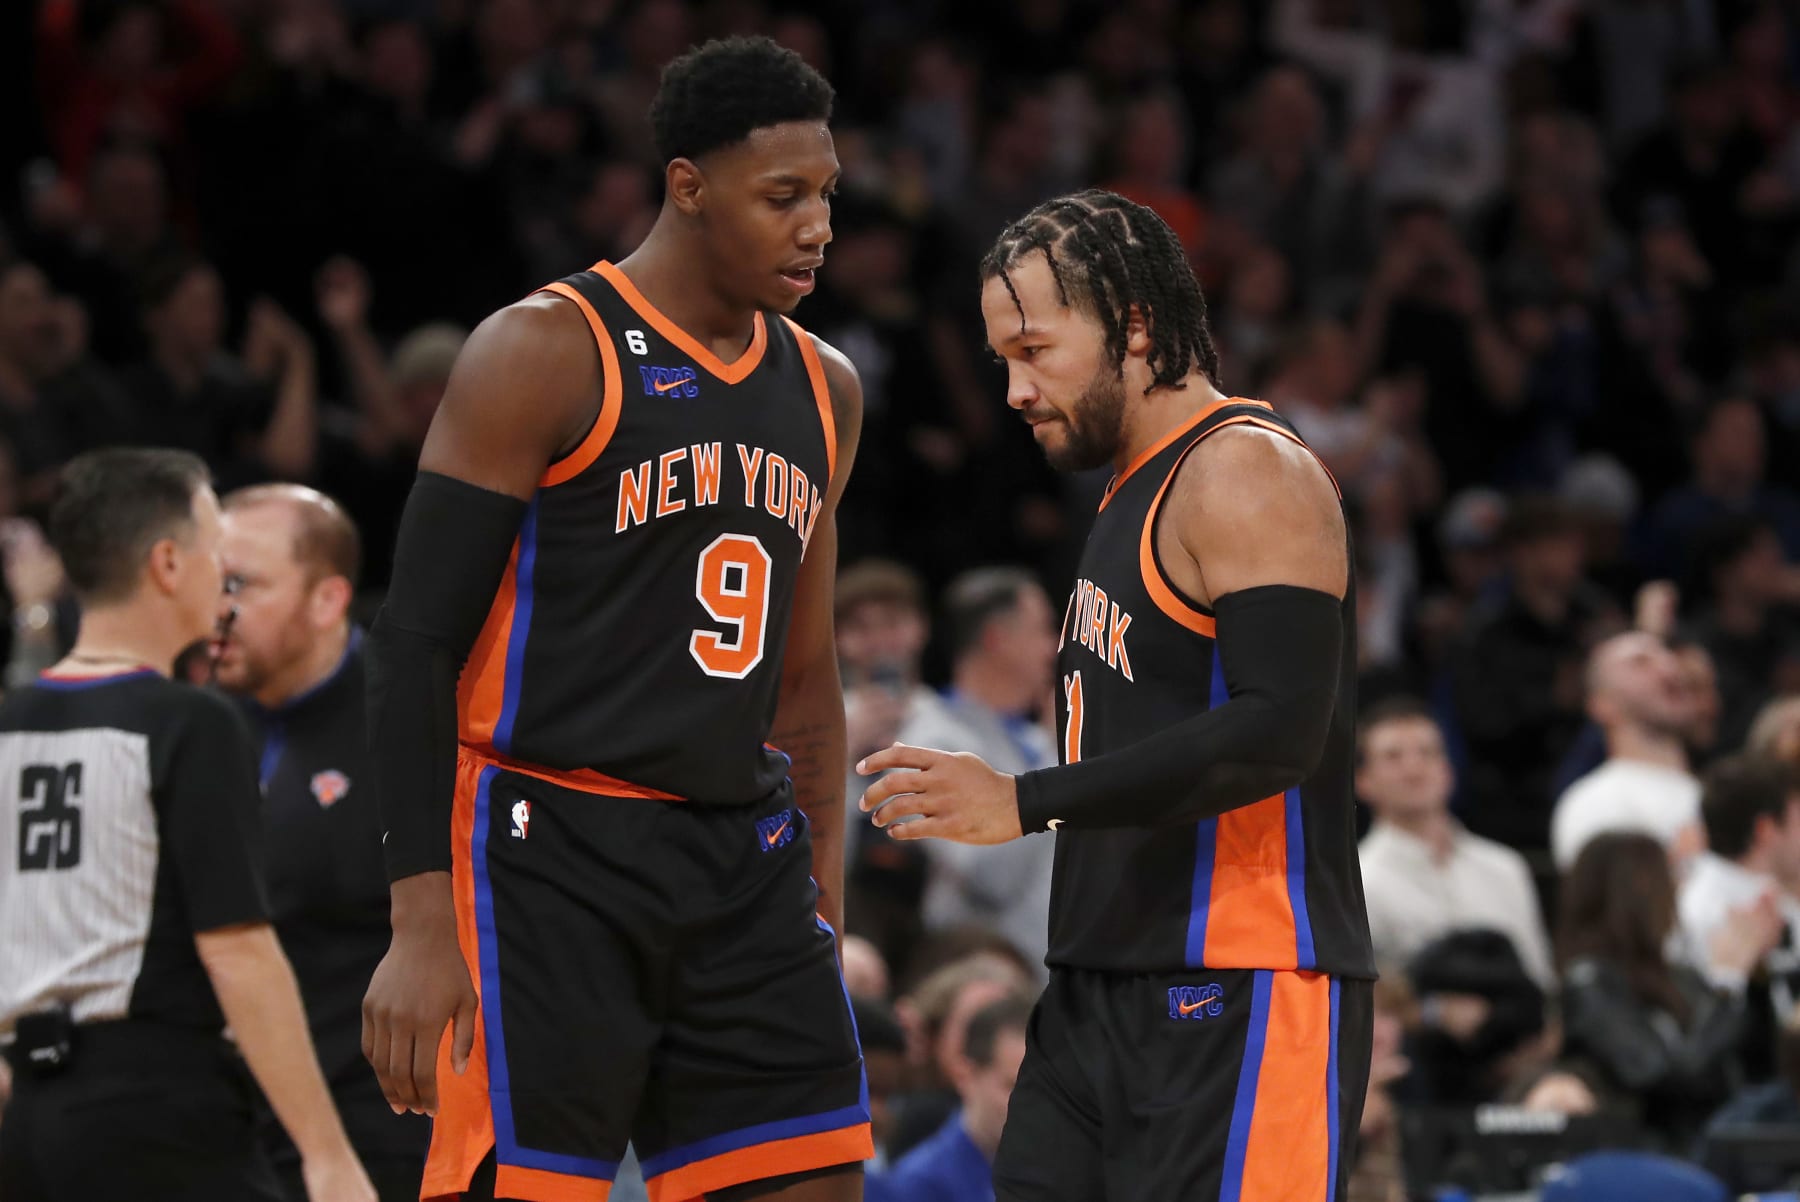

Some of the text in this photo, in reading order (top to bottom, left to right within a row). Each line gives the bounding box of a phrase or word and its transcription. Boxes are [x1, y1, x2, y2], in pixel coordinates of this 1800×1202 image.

[625, 330, 648, 355] 6
[639, 365, 698, 398] NYC
[615, 442, 721, 534] NEW
[689, 533, 772, 680] 9
[1072, 578, 1134, 683] YORK
[19, 761, 83, 871] 26
[755, 808, 795, 852] NYC
[1168, 983, 1223, 1019] NYC
